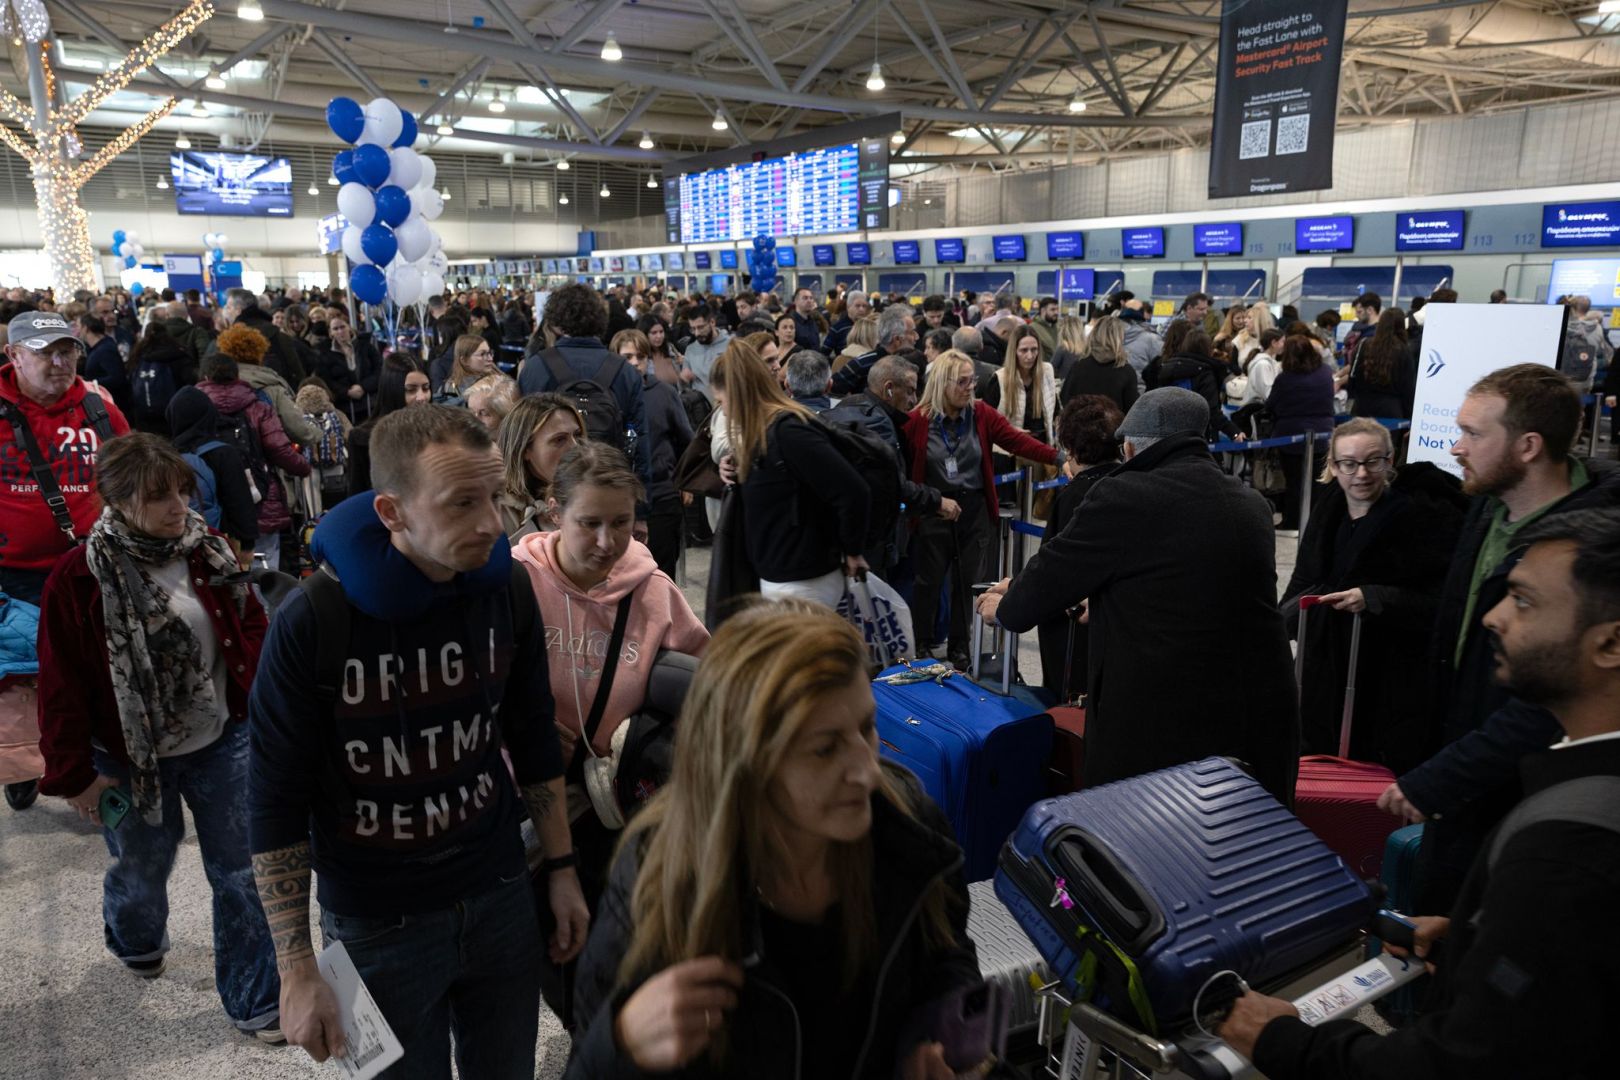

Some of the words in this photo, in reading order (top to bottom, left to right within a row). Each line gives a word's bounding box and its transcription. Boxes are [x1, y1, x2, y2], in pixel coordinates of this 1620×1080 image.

[1237, 23, 1261, 38] Head
[1262, 15, 1300, 32] straight
[1301, 13, 1312, 23] to
[1236, 39, 1252, 51] the
[1253, 34, 1273, 48] Fast
[1275, 31, 1298, 43] Lane
[1300, 23, 1322, 37] with
[1292, 36, 1328, 52] Airport
[1235, 63, 1271, 78] Security
[1272, 58, 1294, 70] Fast
[1295, 52, 1322, 66] Track
[1473, 235, 1493, 247] 113
[1514, 233, 1535, 246] 112
[1249, 244, 1263, 252] 115
[1277, 243, 1292, 252] 114
[167, 260, 176, 270] B
[217, 265, 227, 274] C
[1423, 403, 1460, 417] Read
[1418, 436, 1444, 450] Not
[1449, 439, 1459, 448] Y
[11, 484, 89, 493] PERFANCE
[544, 626, 639, 665] Adids
